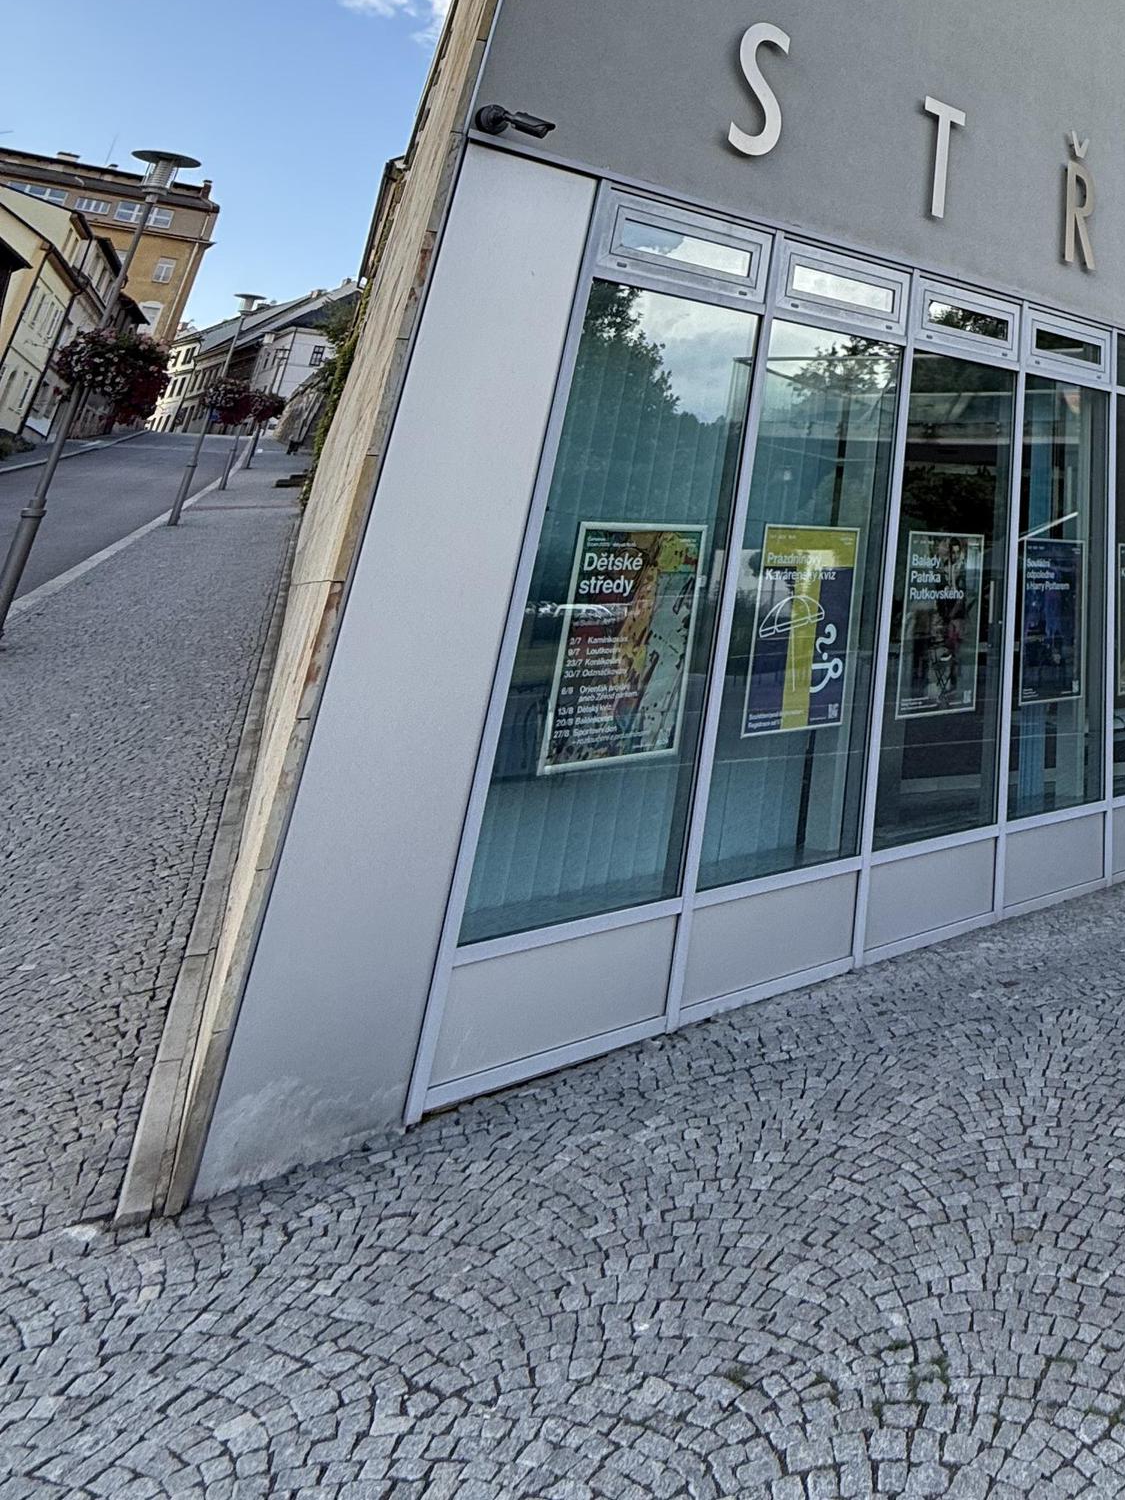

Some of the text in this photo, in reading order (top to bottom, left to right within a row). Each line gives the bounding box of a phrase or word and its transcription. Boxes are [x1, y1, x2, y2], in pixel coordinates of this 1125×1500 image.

[583, 552, 643, 571] Dětské
[912, 553, 941, 569] Balady
[578, 574, 634, 597] středy
[910, 587, 964, 600] Rutkovského
[564, 670, 581, 678] 30/7
